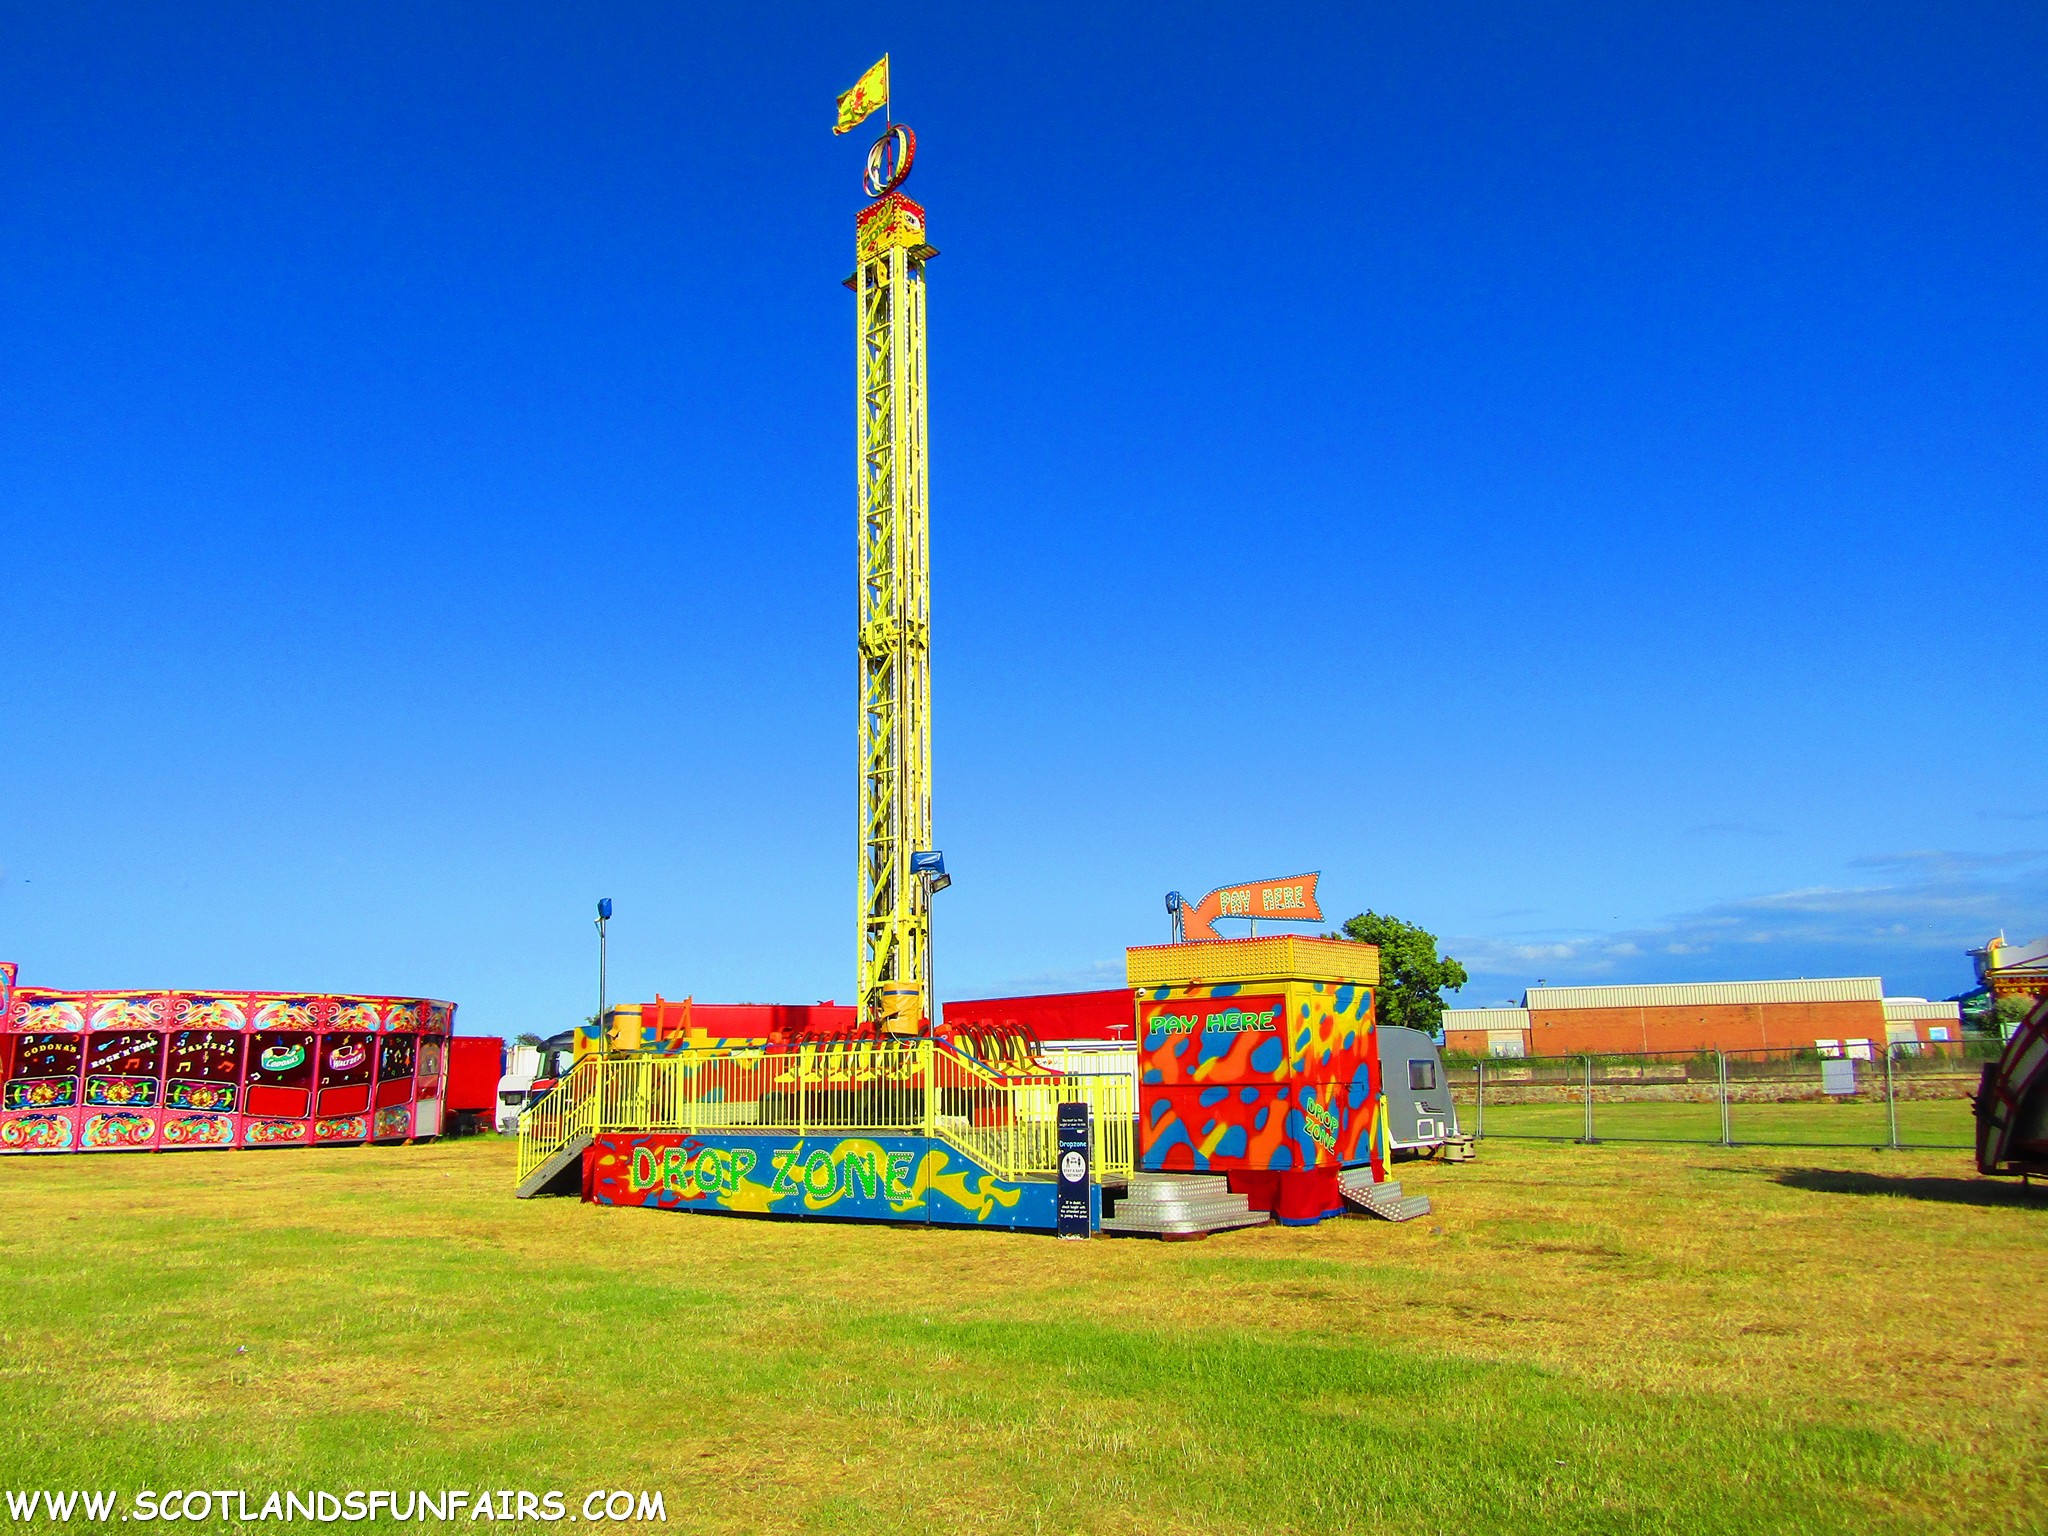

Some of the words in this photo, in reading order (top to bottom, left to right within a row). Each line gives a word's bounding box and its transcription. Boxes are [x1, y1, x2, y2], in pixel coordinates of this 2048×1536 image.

[1220, 890, 1251, 915] PAY
[1262, 886, 1306, 911] HERE
[1150, 1015, 1198, 1034] PAY
[1206, 1011, 1276, 1033] HERE
[178, 1042, 235, 1055] WALTZER
[333, 1053, 362, 1068] WALTZER
[1307, 1097, 1339, 1133] DROP
[1059, 1140, 1087, 1149] Dropzone
[1303, 1116, 1336, 1155] ZONE
[632, 1147, 757, 1193] DROP
[771, 1149, 915, 1200] ZONE
